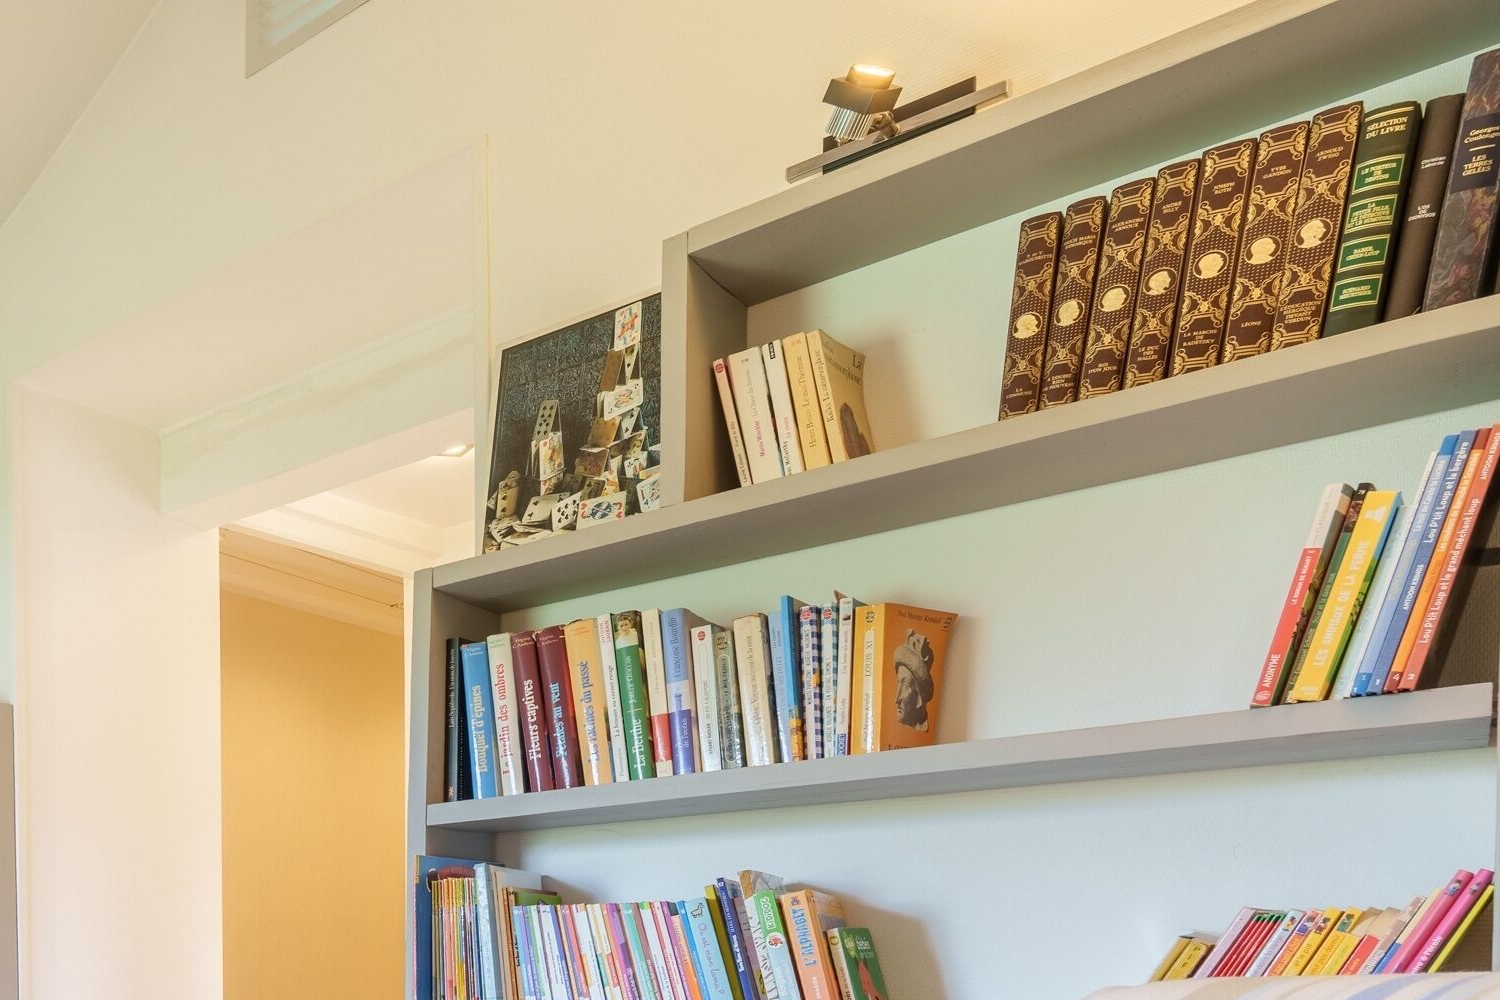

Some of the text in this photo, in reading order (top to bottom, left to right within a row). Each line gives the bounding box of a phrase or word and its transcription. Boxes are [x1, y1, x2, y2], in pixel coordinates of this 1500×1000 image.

[1365, 124, 1406, 140] DU LIVRE
[1366, 116, 1408, 132] SÉLECTION
[1469, 126, 1500, 137] Georges
[1316, 146, 1343, 157] ARNOLD
[1317, 153, 1339, 161] ZWEIG
[1471, 154, 1487, 163] LES
[1461, 165, 1491, 177] GELÉES
[1463, 158, 1493, 170] TERRES
[1262, 168, 1292, 179] GANDON
[1213, 181, 1235, 191] JOSEPH
[1449, 442, 1471, 472] bergère
[1479, 456, 1495, 479] ANTOON
[1435, 491, 1453, 508] Loup
[1464, 498, 1481, 514] loup
[1428, 512, 1443, 526] P'tit
[1422, 528, 1437, 542] Lou
[1452, 517, 1473, 548] méchant
[1444, 550, 1463, 571] grand
[1440, 572, 1453, 580] le
[1310, 540, 1373, 664] LES ANIMAUX DE LA FERME
[1400, 586, 1417, 609] ANTOON
[1429, 591, 1447, 609] Loup
[1423, 612, 1439, 627] P'tit
[666, 616, 679, 644] Bourdin
[1417, 629, 1432, 642] Lou
[863, 652, 872, 677] LOUIS
[1260, 653, 1282, 686] ANONYME
[492, 663, 507, 699] ombres
[576, 661, 593, 687] passé
[547, 682, 561, 702] vent
[578, 689, 593, 703] du
[496, 704, 509, 721] des
[518, 680, 543, 759] Fleurs captives
[550, 705, 563, 718] au
[580, 705, 597, 741] racines
[497, 725, 514, 757] jardin
[837, 733, 845, 755] POCKET
[631, 753, 646, 767] La
